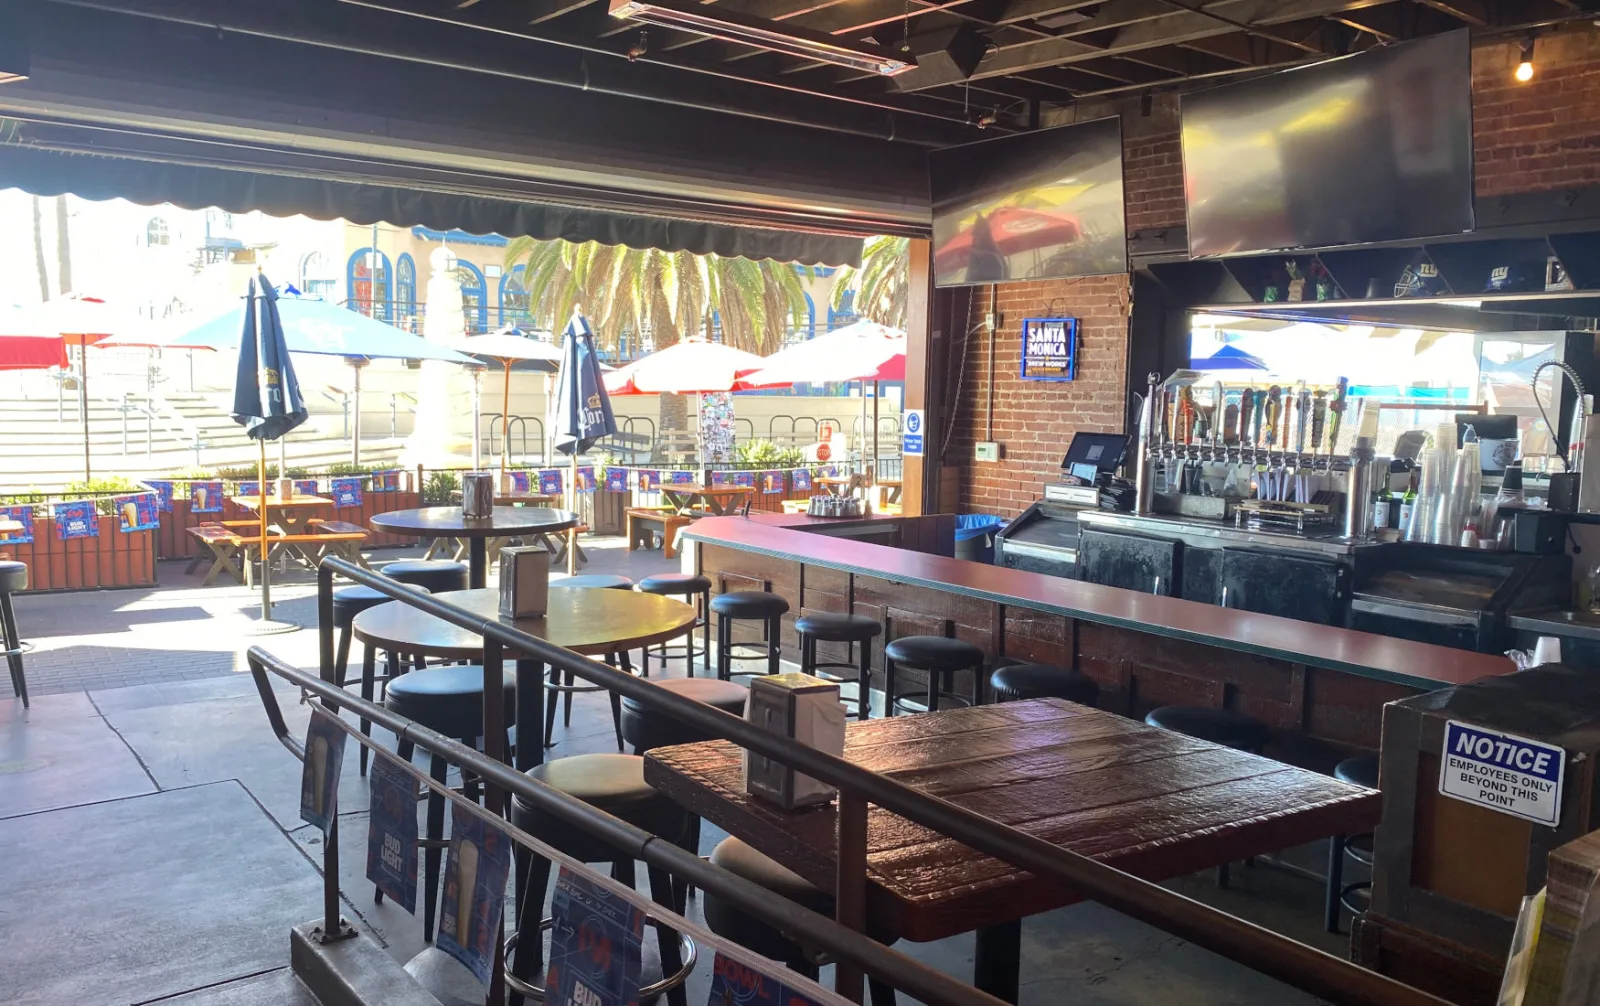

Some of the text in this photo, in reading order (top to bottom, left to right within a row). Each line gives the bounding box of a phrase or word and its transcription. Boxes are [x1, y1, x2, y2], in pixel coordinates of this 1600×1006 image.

[1028, 327, 1066, 343] SANTA
[1028, 342, 1066, 356] MONICA
[1456, 732, 1551, 775] NOTICE
[1449, 757, 1553, 793] EMPLOYEES ONLY
[1460, 772, 1538, 802] BEYOND THIS
[1479, 789, 1516, 807] POINT
[384, 831, 401, 855] BUD
[380, 843, 403, 872] LIGHT
